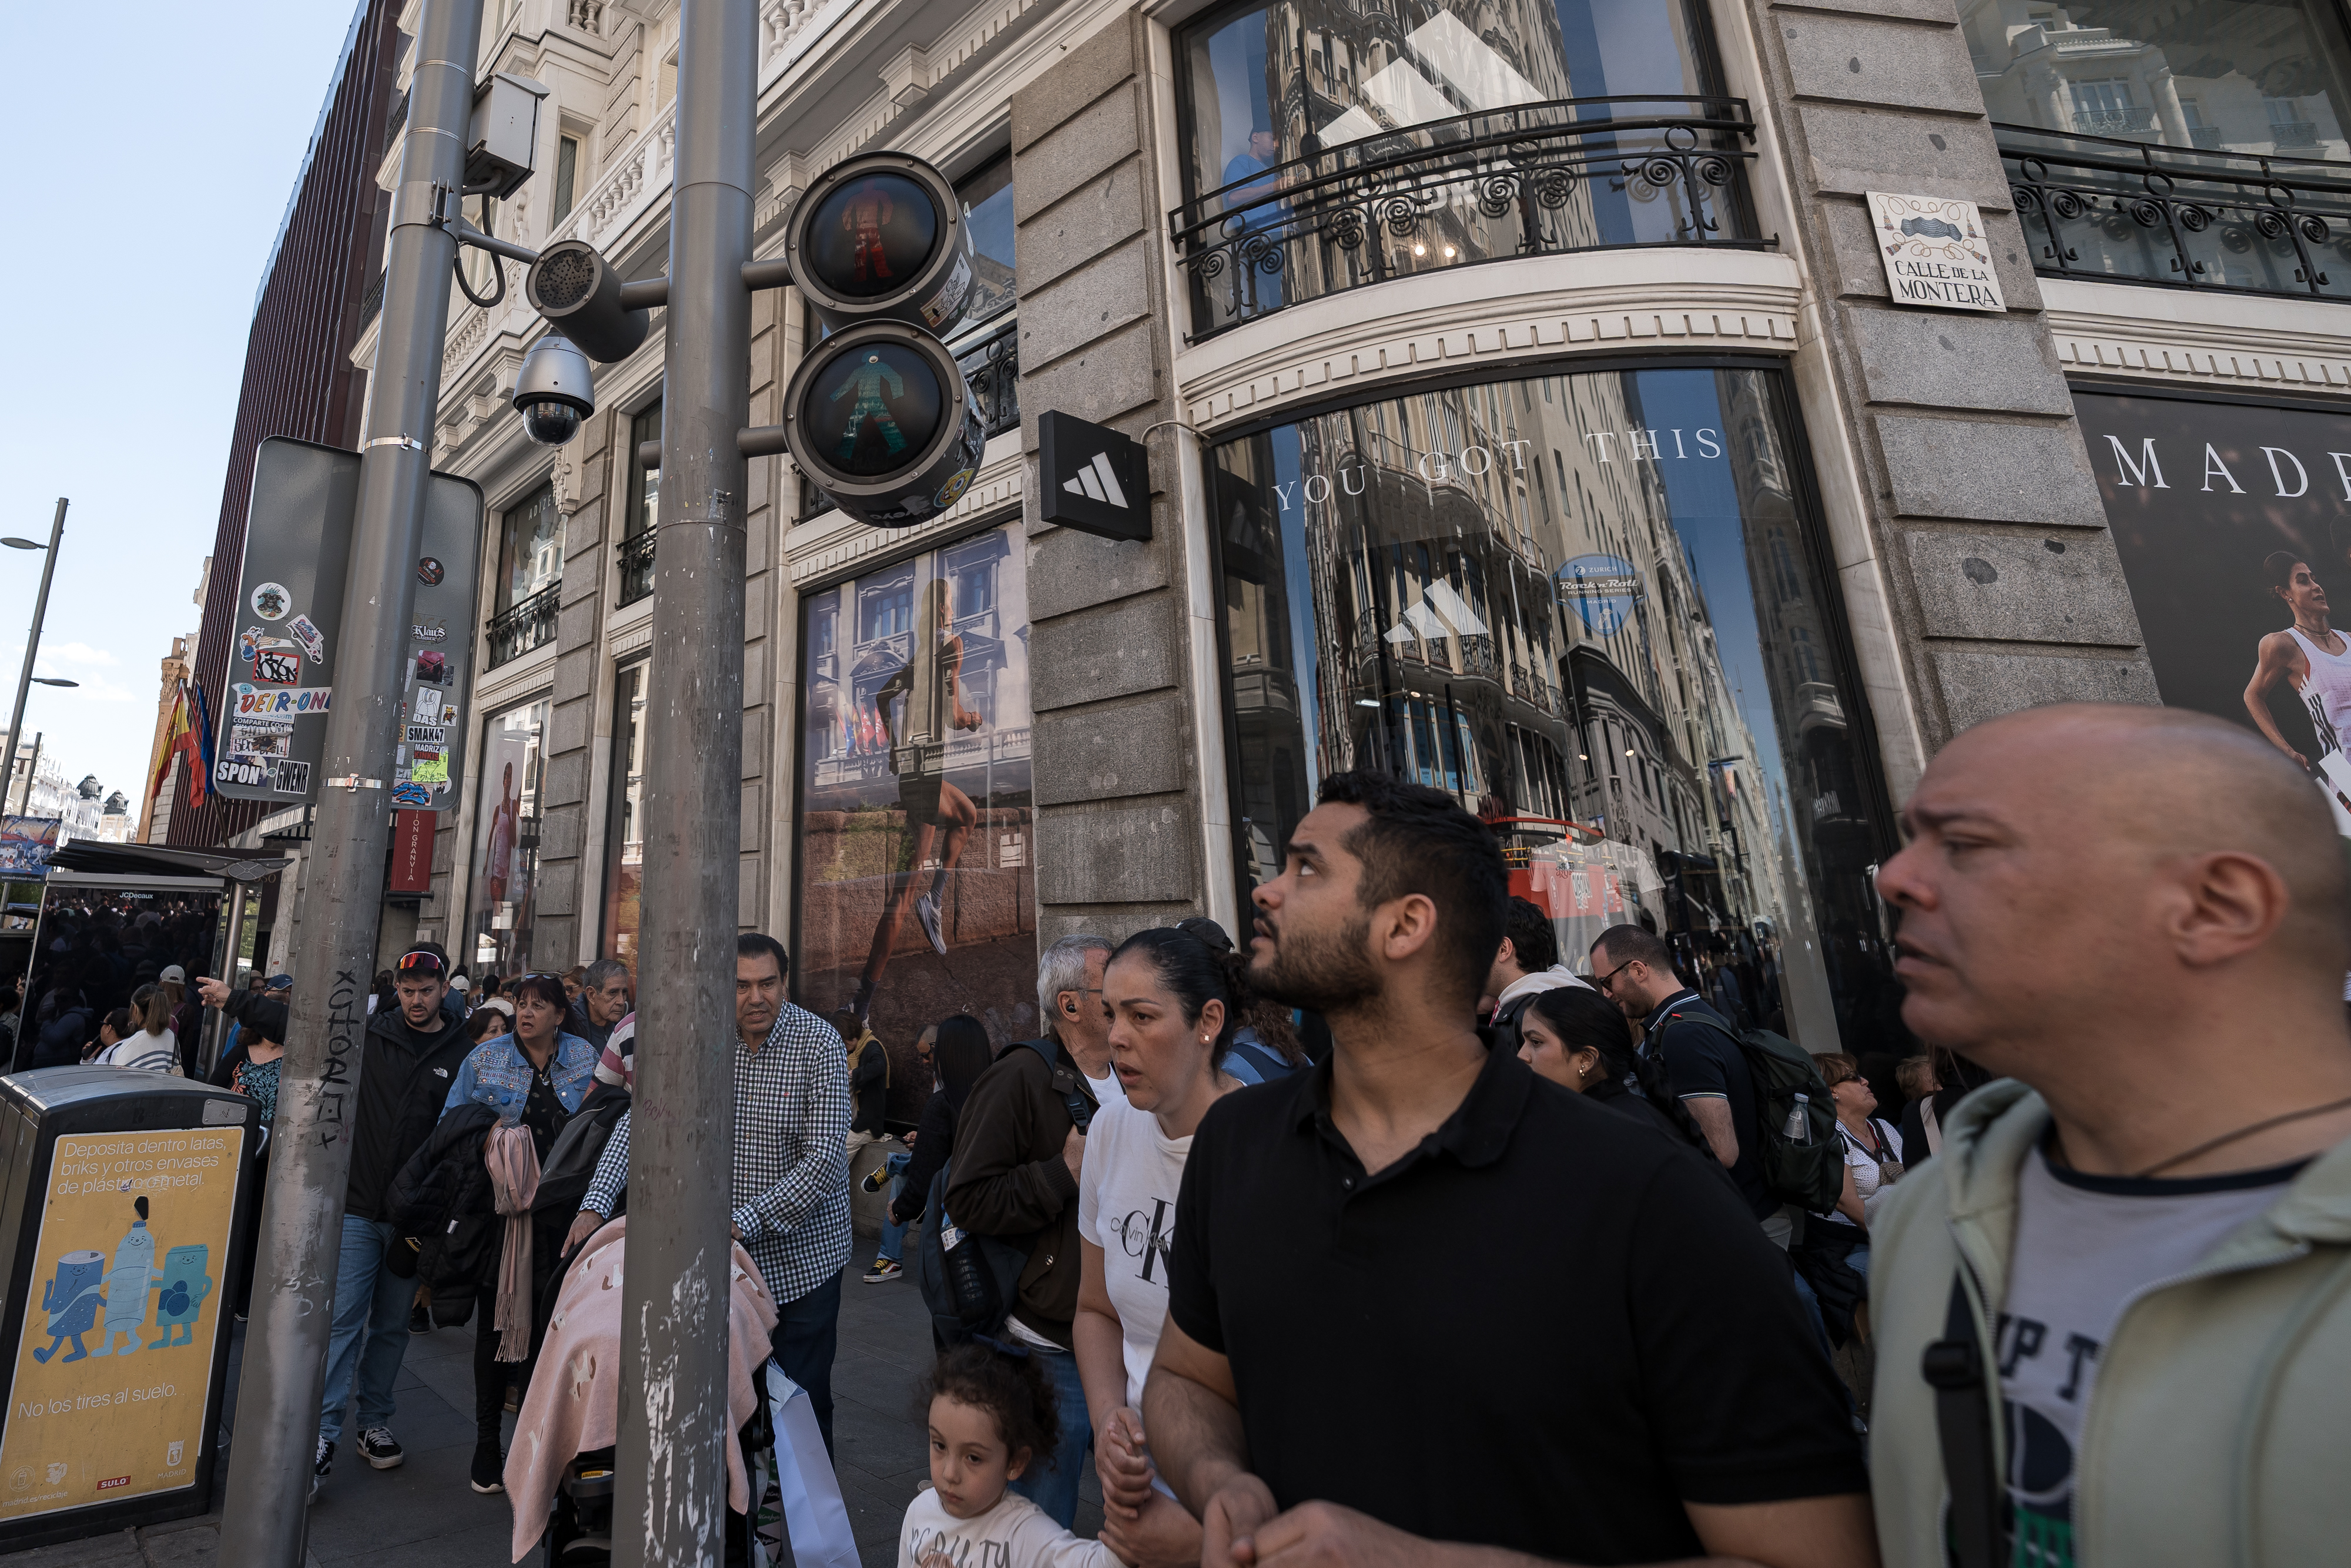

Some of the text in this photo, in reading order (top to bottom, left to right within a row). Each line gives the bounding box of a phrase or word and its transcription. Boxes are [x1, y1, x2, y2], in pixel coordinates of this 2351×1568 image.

[1894, 260, 1990, 281] CALLE DE LA
[1896, 278, 2000, 307] MONTERA
[1271, 427, 1723, 511] YOU GOT THIS
[233, 717, 269, 727] COMPARTE
[413, 713, 437, 726] DAS
[408, 726, 444, 742] SMAK47
[414, 751, 440, 761] KINKIS
[415, 743, 440, 753] MADRIZ
[217, 761, 260, 785] SPON
[276, 760, 309, 793] GWENR
[64, 1137, 227, 1159] Deposita dentro latas,
[61, 1155, 219, 1176] briks y otros envases
[58, 1180, 79, 1194] de
[160, 1171, 205, 1187] metal.
[1110, 1217, 1173, 1252] Calvin Klein
[18, 1382, 178, 1419] No los tires al suelo.
[101, 1477, 126, 1489] SULO
[157, 1468, 187, 1479] MADRID
[2, 1490, 68, 1507] madrid.es/reciclaje
